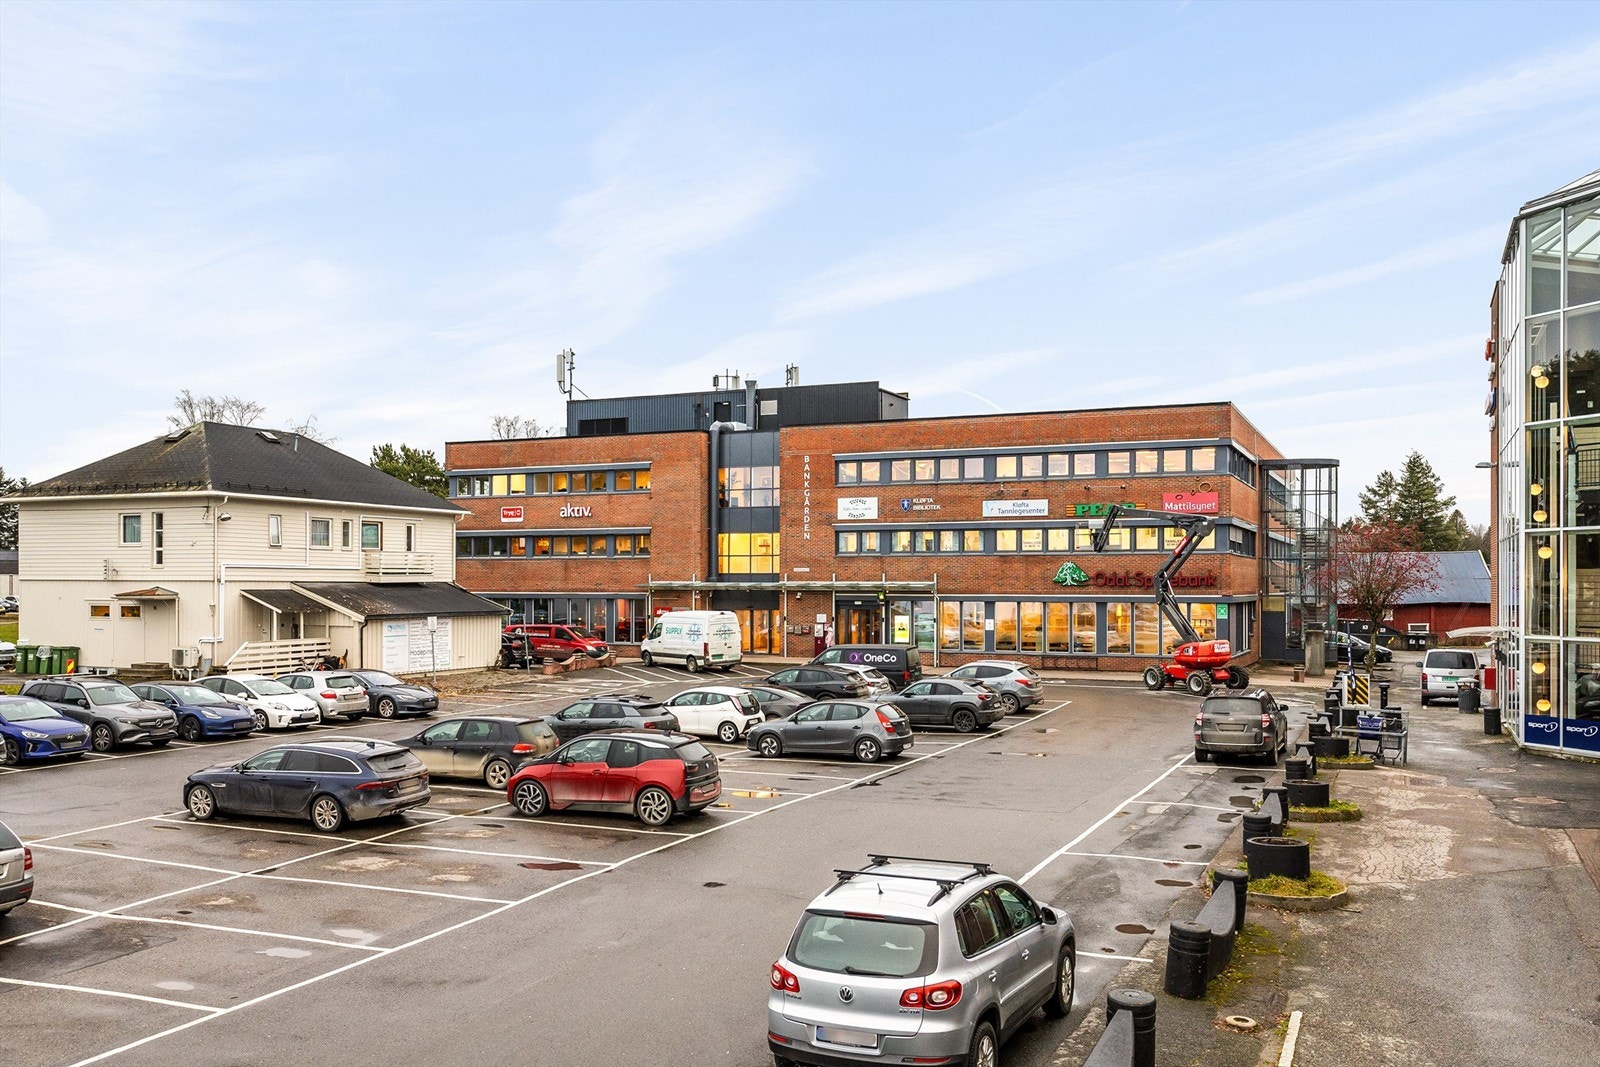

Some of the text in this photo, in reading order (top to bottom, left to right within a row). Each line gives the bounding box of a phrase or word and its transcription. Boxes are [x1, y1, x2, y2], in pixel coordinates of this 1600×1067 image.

[997, 507, 1046, 515] Tannlegesenter
[1164, 501, 1216, 512] Mattilsynet
[1093, 571, 1217, 590] Odal Spebank
[665, 626, 683, 635] SUPPLY
[864, 653, 897, 662] OneCo
